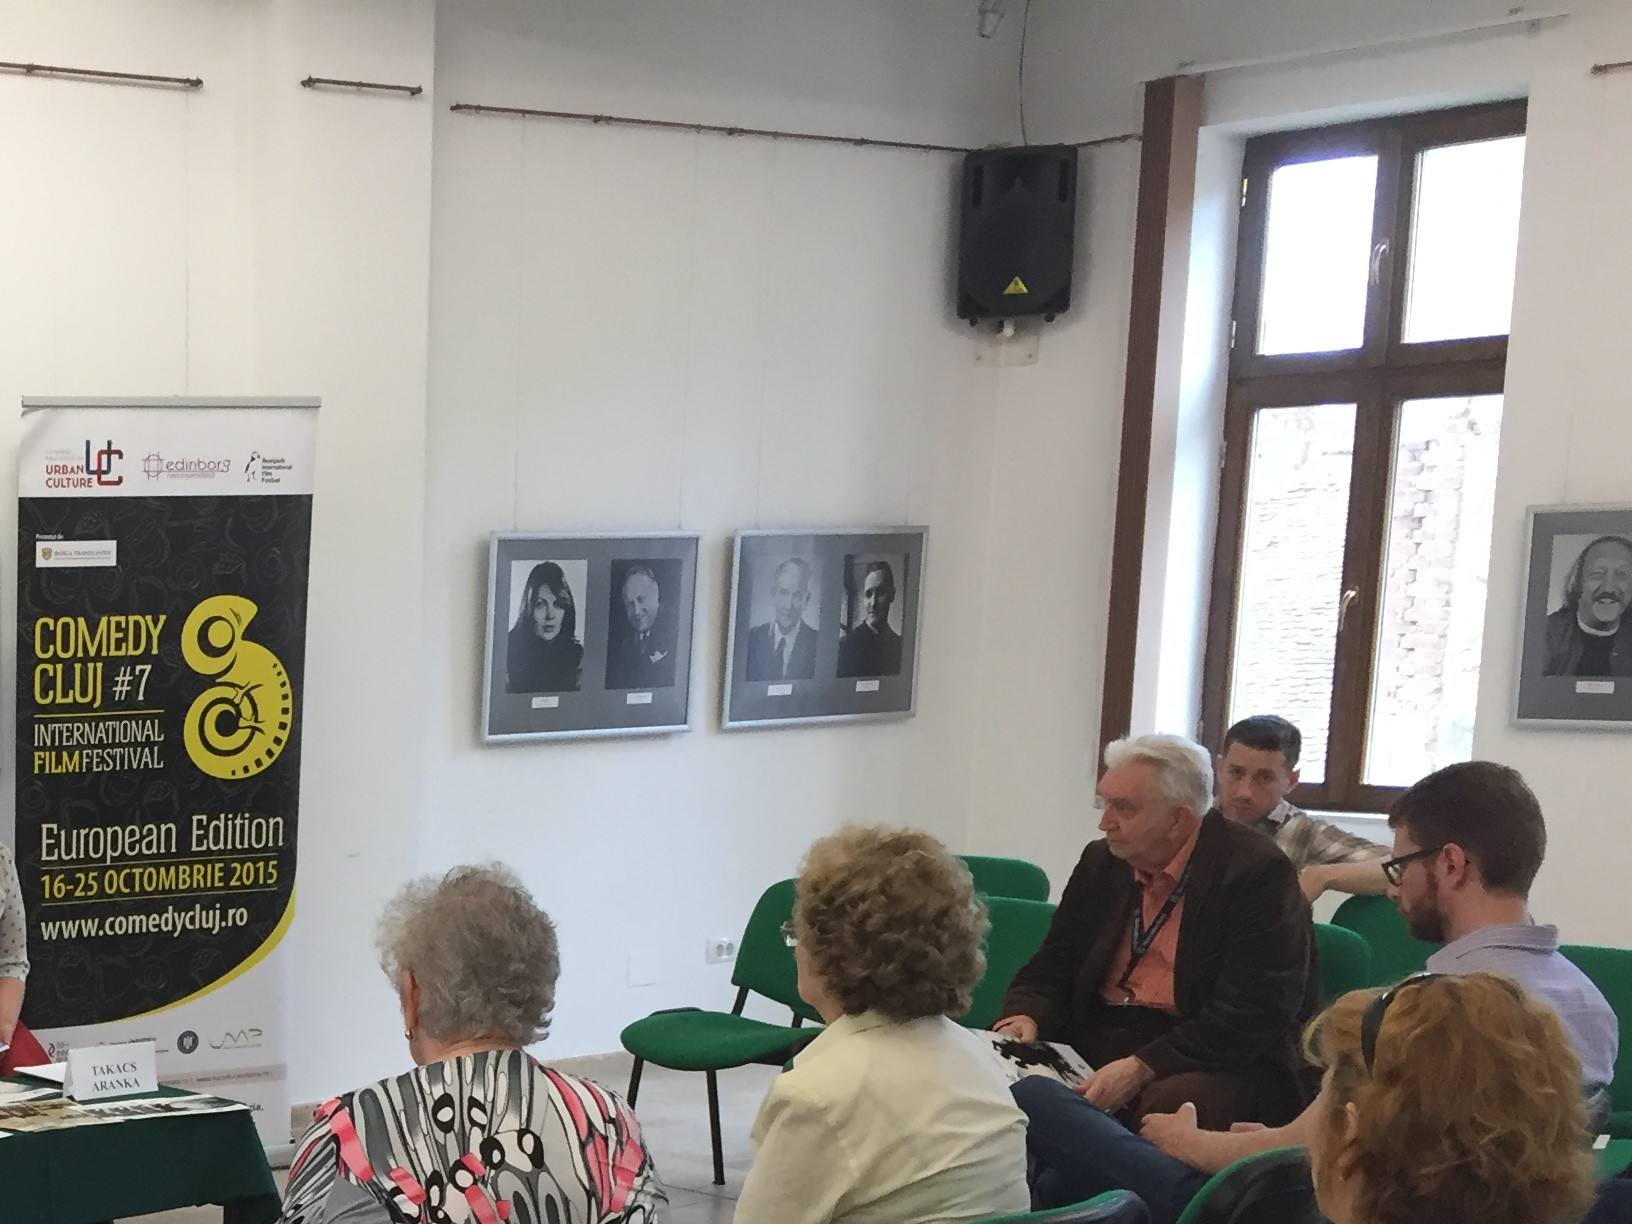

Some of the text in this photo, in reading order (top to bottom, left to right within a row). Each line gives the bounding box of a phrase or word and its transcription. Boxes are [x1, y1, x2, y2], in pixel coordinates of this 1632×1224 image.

[45, 464, 84, 475] URBAN
[165, 458, 231, 473] edinborg
[45, 477, 93, 488] CULTURE
[34, 614, 167, 659] COMEDY
[34, 662, 153, 708] CLUJ #7
[33, 719, 165, 747] INTERNATIONAL
[40, 811, 284, 865] European Edition
[40, 860, 278, 899] 16-25 OCTOMBRIE 2015
[40, 903, 248, 941] www.comedycluj.ro
[92, 1062, 137, 1076] TAKACS
[92, 1078, 140, 1092] ARANKA
